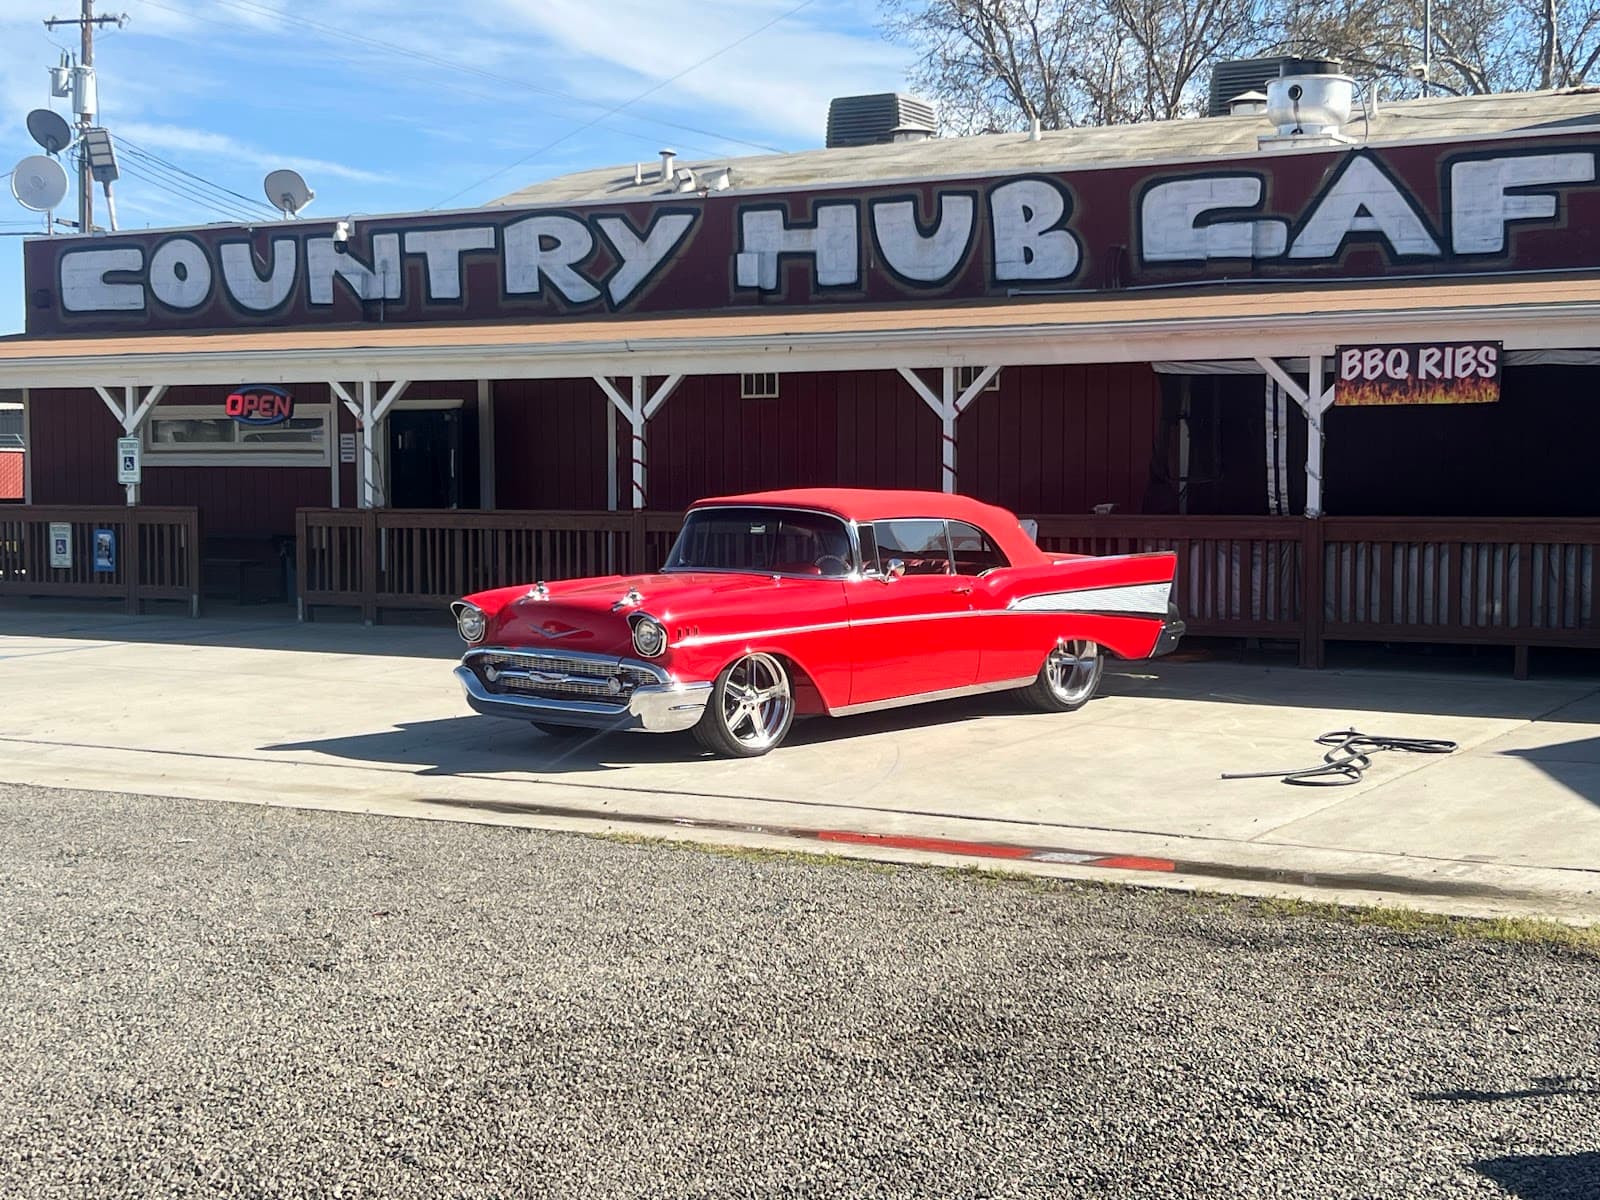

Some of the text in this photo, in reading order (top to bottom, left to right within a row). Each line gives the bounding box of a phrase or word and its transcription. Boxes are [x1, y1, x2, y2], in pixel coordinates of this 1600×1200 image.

[59, 152, 1596, 312] COUNTRY HUB CAF
[1340, 345, 1497, 381] BBQ RIBS
[225, 393, 291, 417] OPEN
